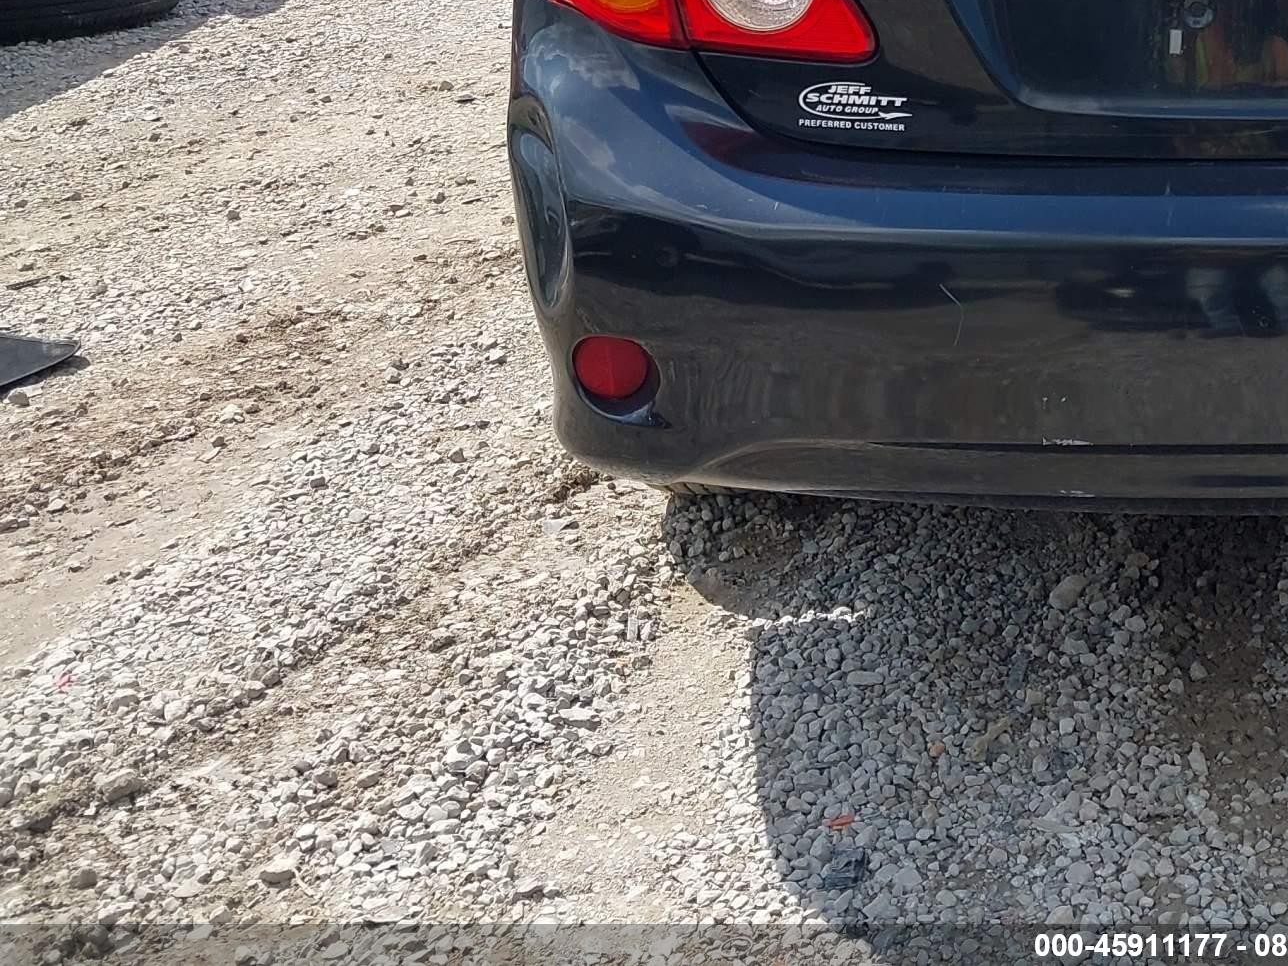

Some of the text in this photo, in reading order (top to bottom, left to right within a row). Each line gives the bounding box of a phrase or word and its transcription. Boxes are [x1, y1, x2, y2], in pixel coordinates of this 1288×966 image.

[828, 85, 872, 95] JEFF
[805, 93, 907, 107] SCHMITT
[815, 104, 879, 115] AUTO GROUP
[798, 118, 905, 132] PREFERRED CUSTOMER
